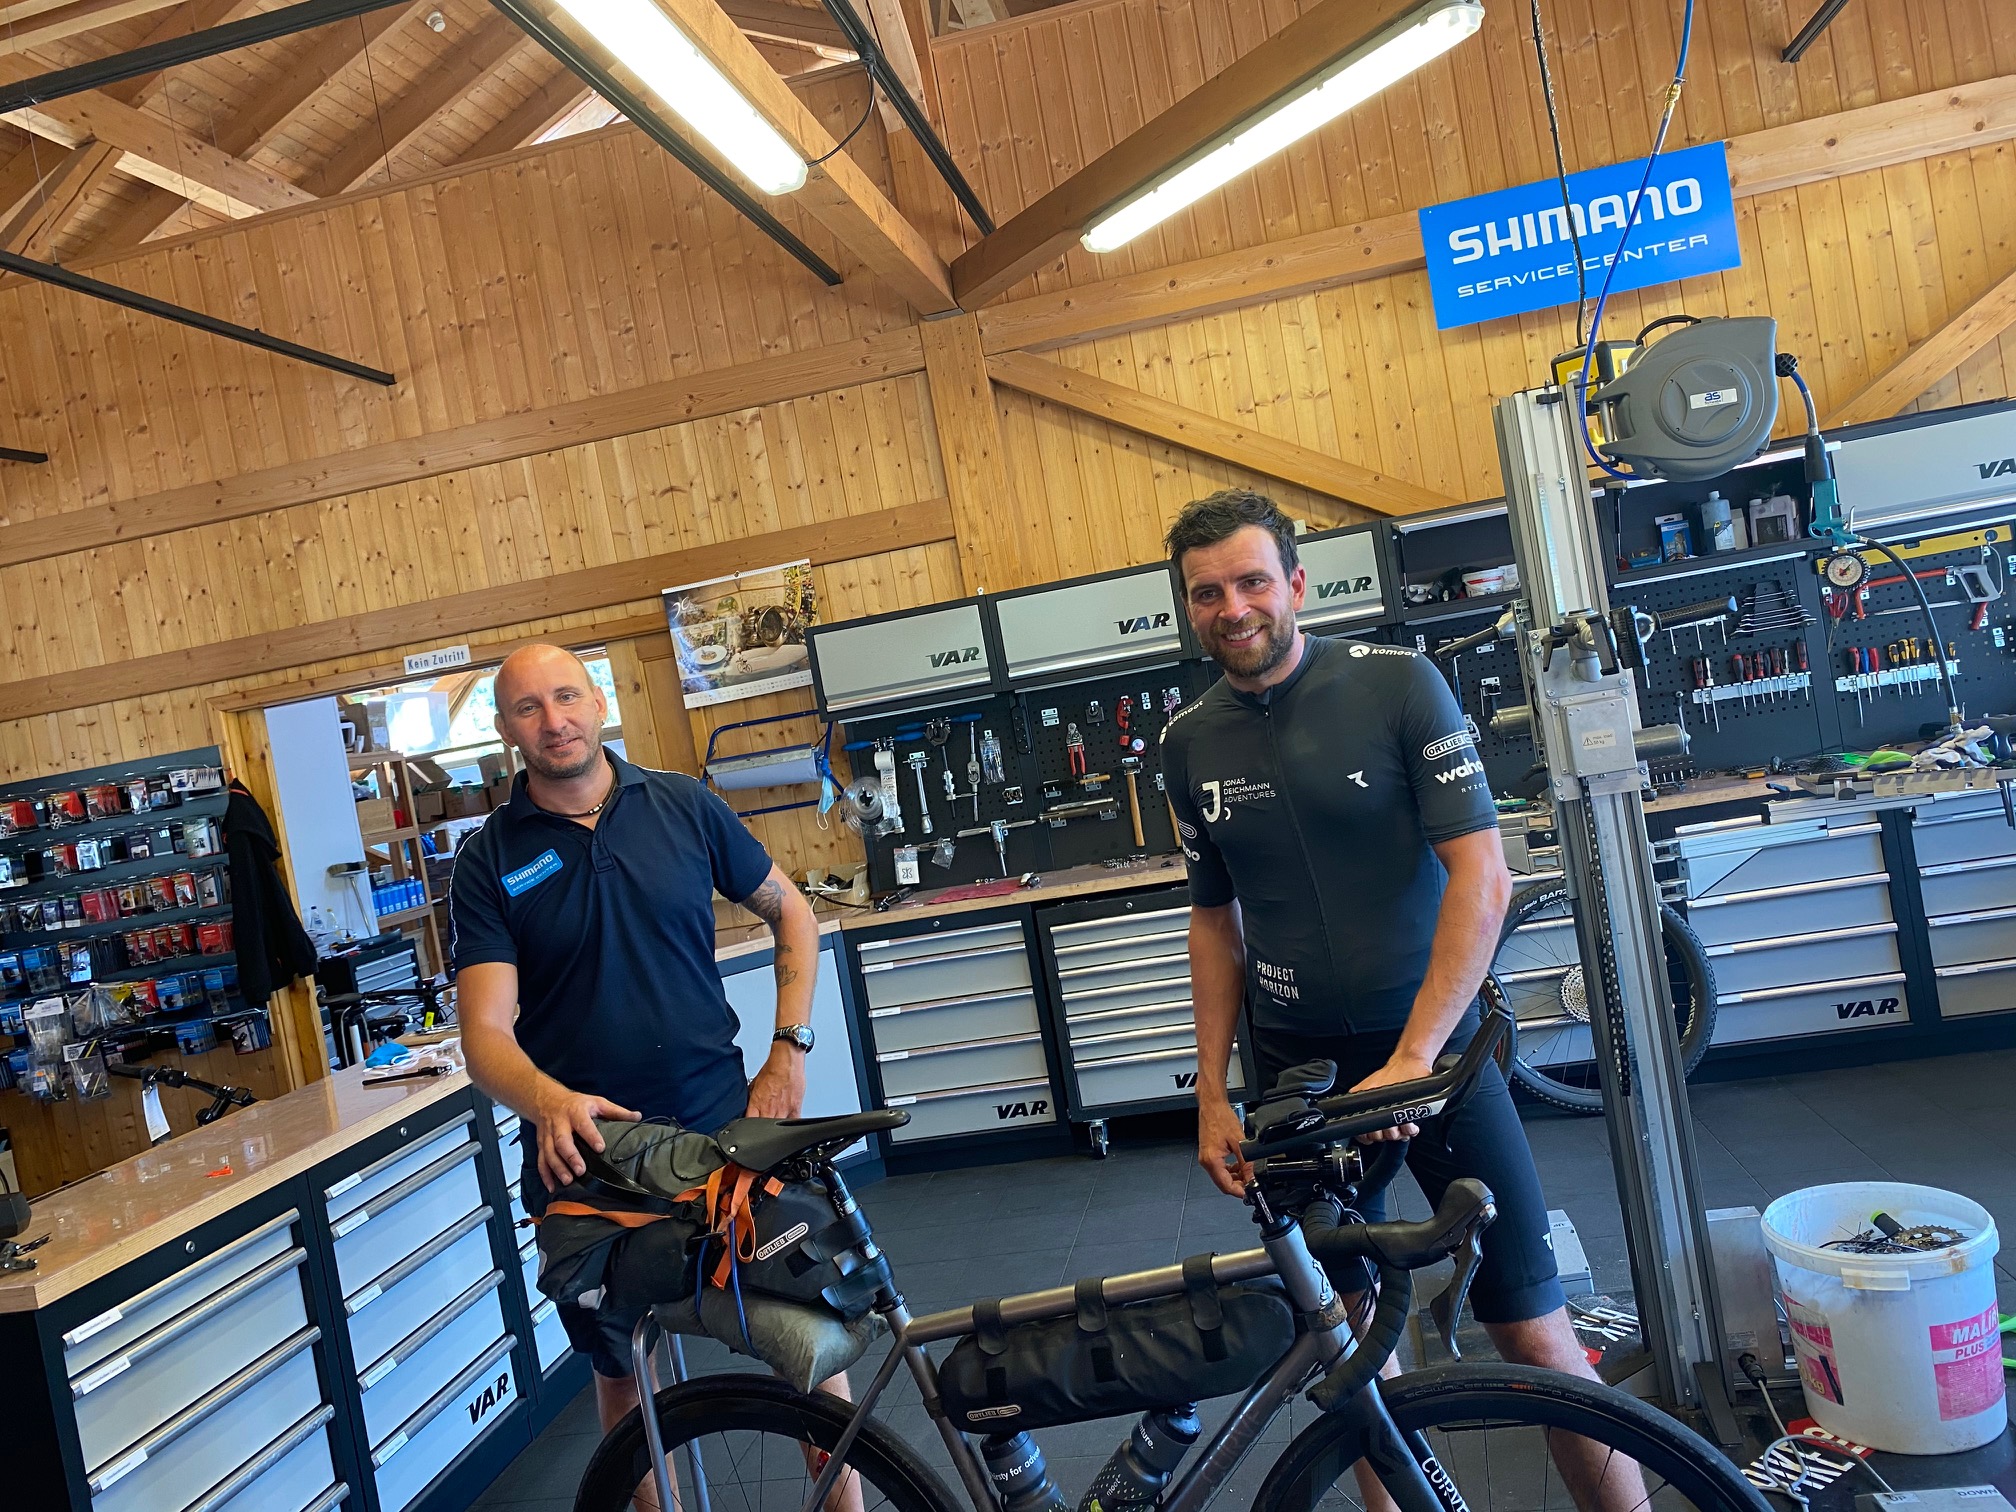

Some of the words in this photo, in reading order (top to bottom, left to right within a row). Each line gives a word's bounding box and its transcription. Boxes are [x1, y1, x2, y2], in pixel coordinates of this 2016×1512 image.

[1448, 177, 1703, 265] SHIMANO
[1457, 262, 1574, 298] SERVICE
[1583, 233, 1709, 272] CENTER
[1311, 576, 1375, 599] VAR
[1113, 612, 1173, 635] VAR
[407, 657, 429, 670] Kein
[432, 650, 465, 665] Zutritt
[925, 646, 983, 668] VAR
[1428, 736, 1463, 756] ORTLIEB
[1222, 777, 1246, 788] JONAS
[1223, 783, 1270, 796] DEICHMANN
[1223, 790, 1277, 804] ADVENTURES
[507, 854, 553, 886] SHIMANO
[1256, 960, 1295, 982] PROJECT
[1259, 976, 1300, 1000] HORIZON
[1830, 997, 1902, 1019] VAR
[992, 1100, 1051, 1120] VAR
[758, 1237, 786, 1258] ORTLIEB
[1955, 1342, 1985, 1360] PLUS
[464, 1372, 512, 1425] VAR
[1010, 1465, 1022, 1477] for
